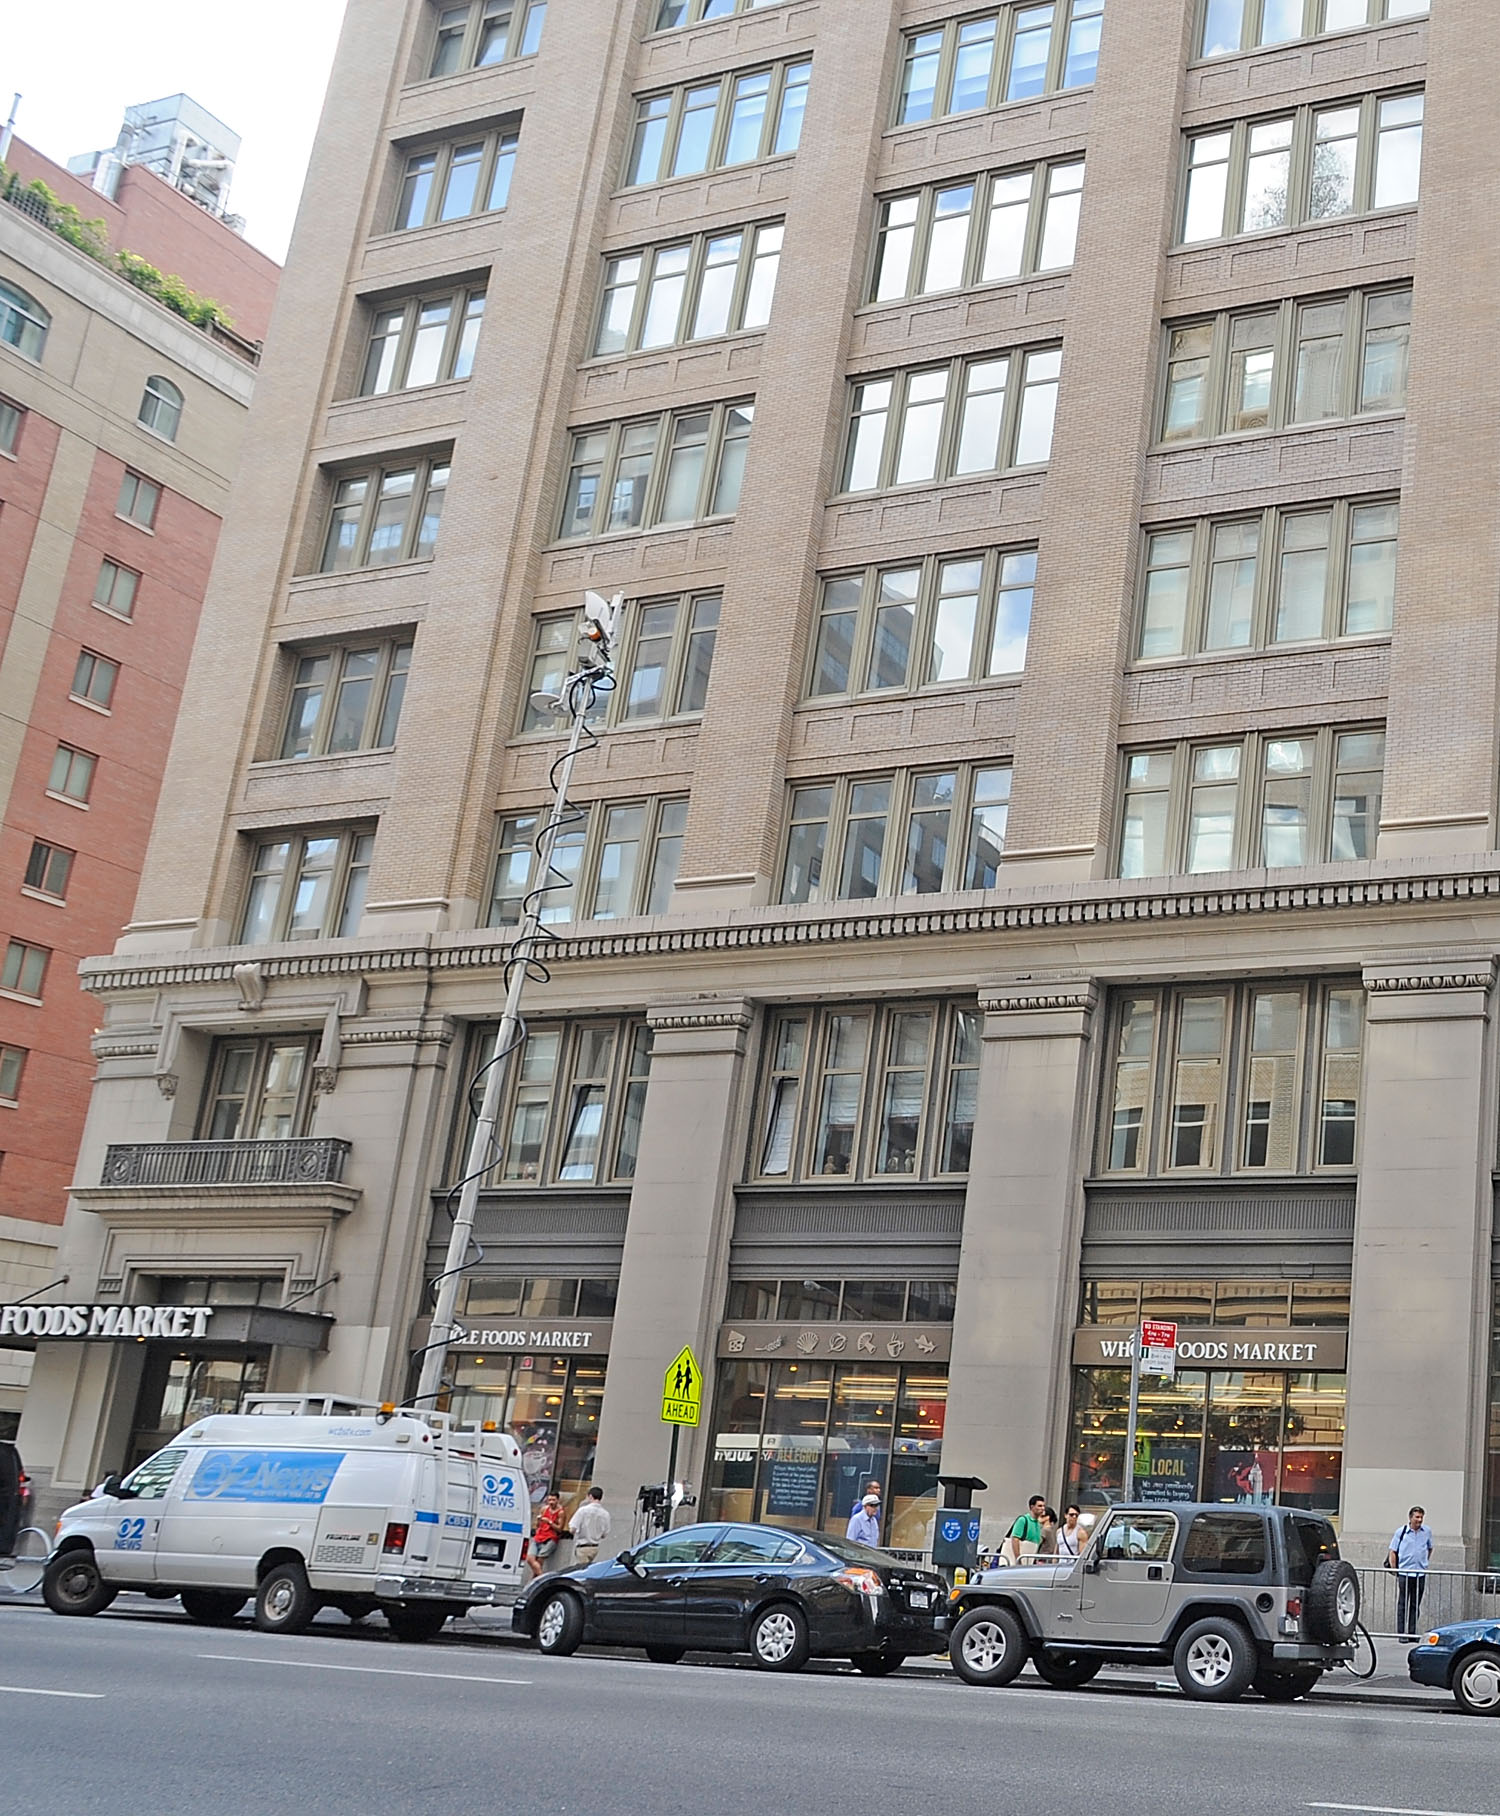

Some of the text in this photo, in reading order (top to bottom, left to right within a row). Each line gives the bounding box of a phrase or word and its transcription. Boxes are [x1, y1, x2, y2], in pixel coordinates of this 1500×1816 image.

[0, 1306, 213, 1338] FOODS MARKET
[480, 1331, 526, 1346] FOODS
[529, 1332, 592, 1348] MARKET
[1233, 1343, 1317, 1361] MARKET
[666, 1403, 695, 1419] AHEAD
[777, 1449, 818, 1463] ALLEGRO
[1151, 1459, 1186, 1476] LOCAL
[499, 1476, 514, 1497] 2
[482, 1495, 514, 1508] NEWS
[129, 1518, 145, 1539] 2
[114, 1539, 142, 1550] NEWS
